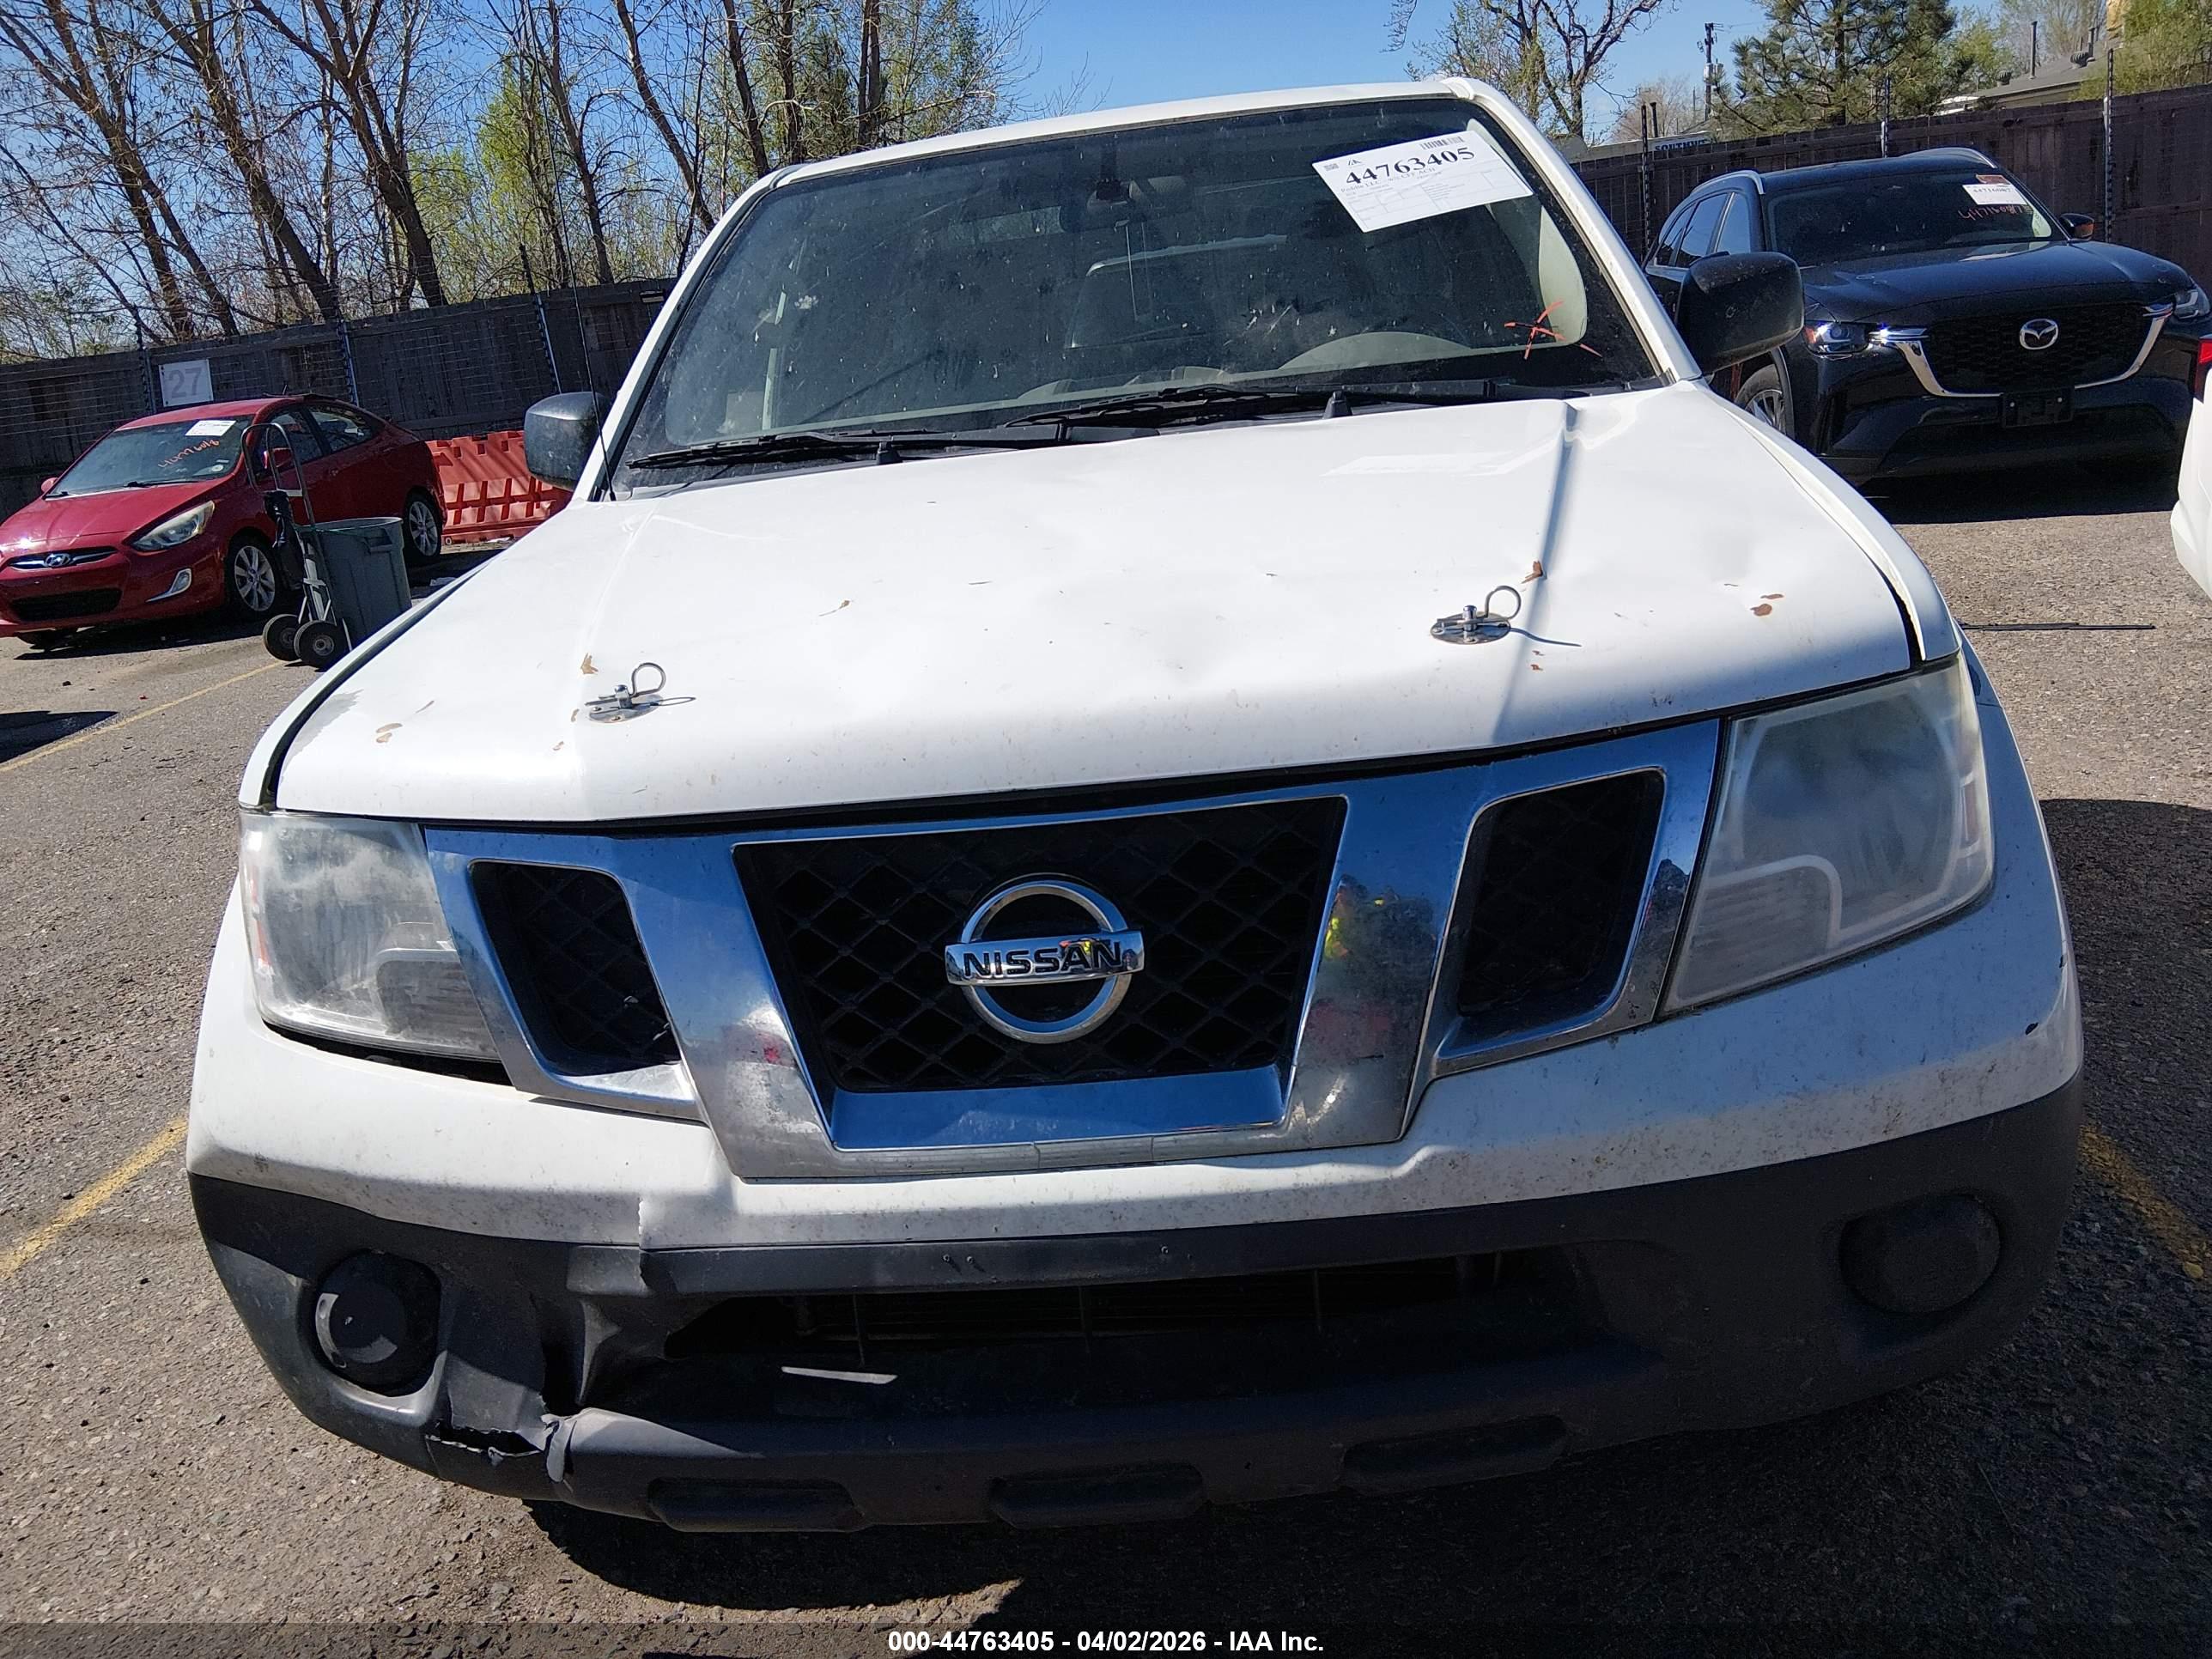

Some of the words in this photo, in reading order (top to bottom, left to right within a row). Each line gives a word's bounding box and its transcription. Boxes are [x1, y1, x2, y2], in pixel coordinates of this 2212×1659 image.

[1346, 147, 1475, 184] 44763405
[168, 367, 202, 398] 27
[963, 939, 1122, 978] NISSAN
